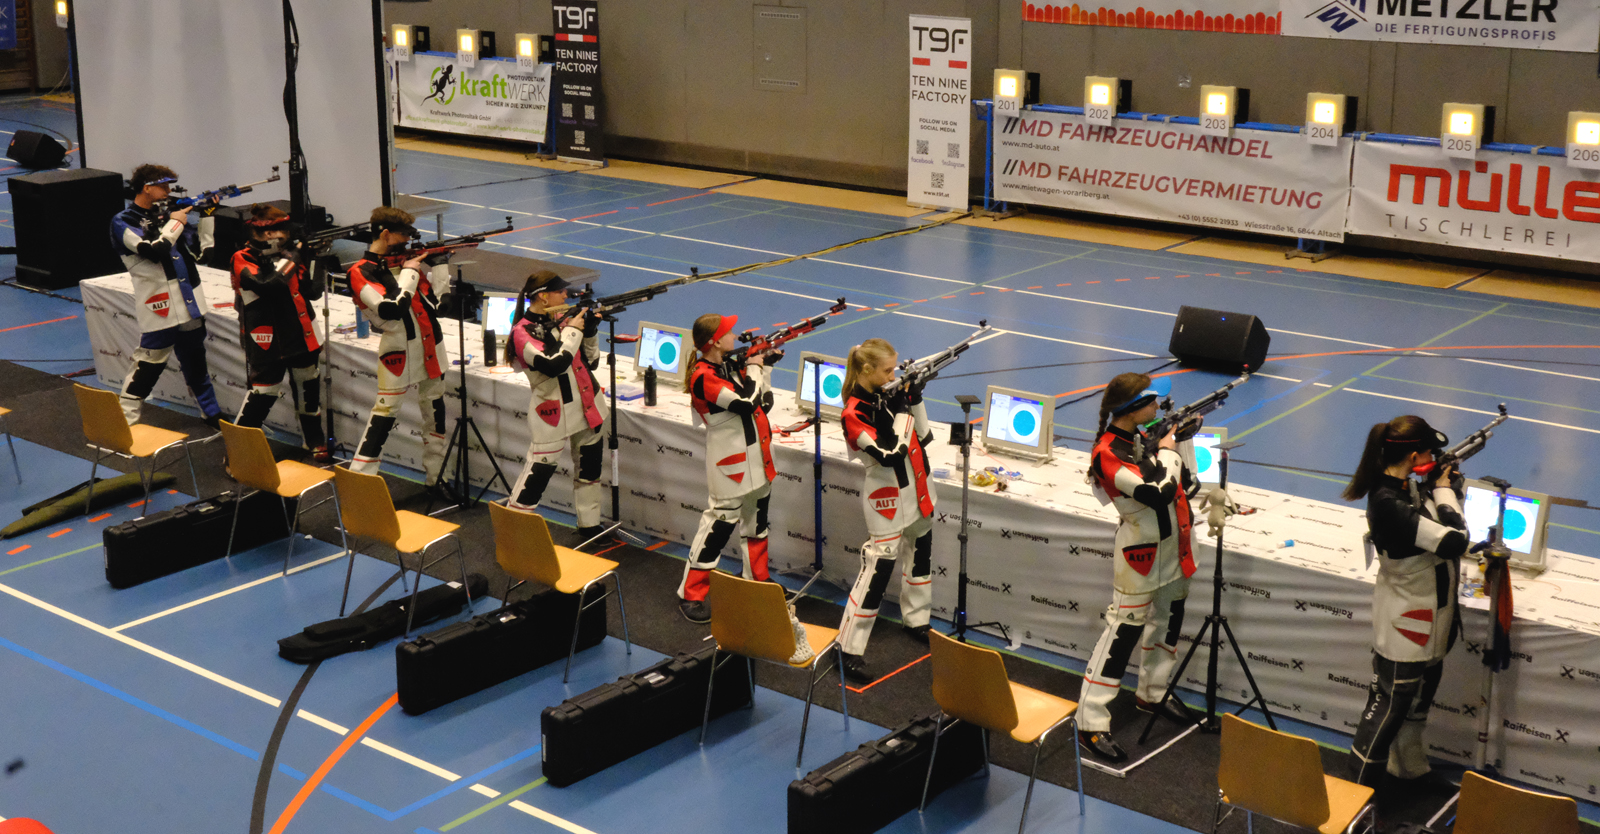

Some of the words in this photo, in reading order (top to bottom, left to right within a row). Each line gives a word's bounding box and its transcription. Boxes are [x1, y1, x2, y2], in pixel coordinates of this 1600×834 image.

[553, 6, 596, 29] T9F
[1375, 22, 1397, 33] DIE
[1404, 24, 1556, 41] FERTIGUNGSPROFIS
[913, 26, 968, 53] T9F
[460, 54, 473, 63] 107
[556, 49, 573, 59] TEN
[576, 50, 598, 61] NINE
[556, 62, 598, 74] FACTORY
[912, 75, 935, 87] TEN
[938, 77, 967, 90] NINE
[911, 90, 967, 105] FACTORY
[520, 103, 546, 111] ZUKUNFT
[998, 100, 1016, 111] 201
[1089, 107, 1109, 120] 202
[1205, 118, 1227, 130] 203
[1311, 127, 1334, 140] 204
[1002, 140, 1060, 152] www.md-auto.at
[1059, 122, 1273, 159] FAHRZEUGHANDEL
[1447, 139, 1472, 152] 205
[911, 156, 934, 165] facebook
[1572, 149, 1600, 162] 206
[1002, 182, 1110, 200] www.mietwagen-vorarlberg.at
[1058, 165, 1323, 210] FAHRZEUGVERMIETUNG
[1178, 213, 1190, 221] +43
[1202, 216, 1218, 224] 5552
[1220, 218, 1239, 226] 21933
[1244, 221, 1285, 232] Wiesstraße
[1297, 227, 1316, 236] 6844
[1317, 230, 1342, 239] Altach
[1385, 213, 1571, 248] TISCHLEREI
[152, 300, 168, 310] AUT
[255, 334, 272, 342] AUT
[385, 358, 402, 366] AUT
[540, 408, 558, 416] AUT
[776, 470, 802, 483] Raiffeise
[829, 484, 860, 497] Raiffeisen
[875, 498, 896, 509] AUT
[949, 513, 982, 529] Raiffisen
[1013, 529, 1049, 544] Raiffeisen
[1081, 546, 1114, 560] aiffeisen
[1128, 552, 1154, 563] AUT
[966, 577, 1000, 592] Raiffeisen
[1229, 582, 1271, 599] Raiffeisen
[1031, 594, 1067, 610] Raiffeisen
[1309, 601, 1354, 620] Raiffeisen
[1247, 651, 1290, 669] Raiffeisen
[1503, 719, 1552, 740] Raiffeisen
